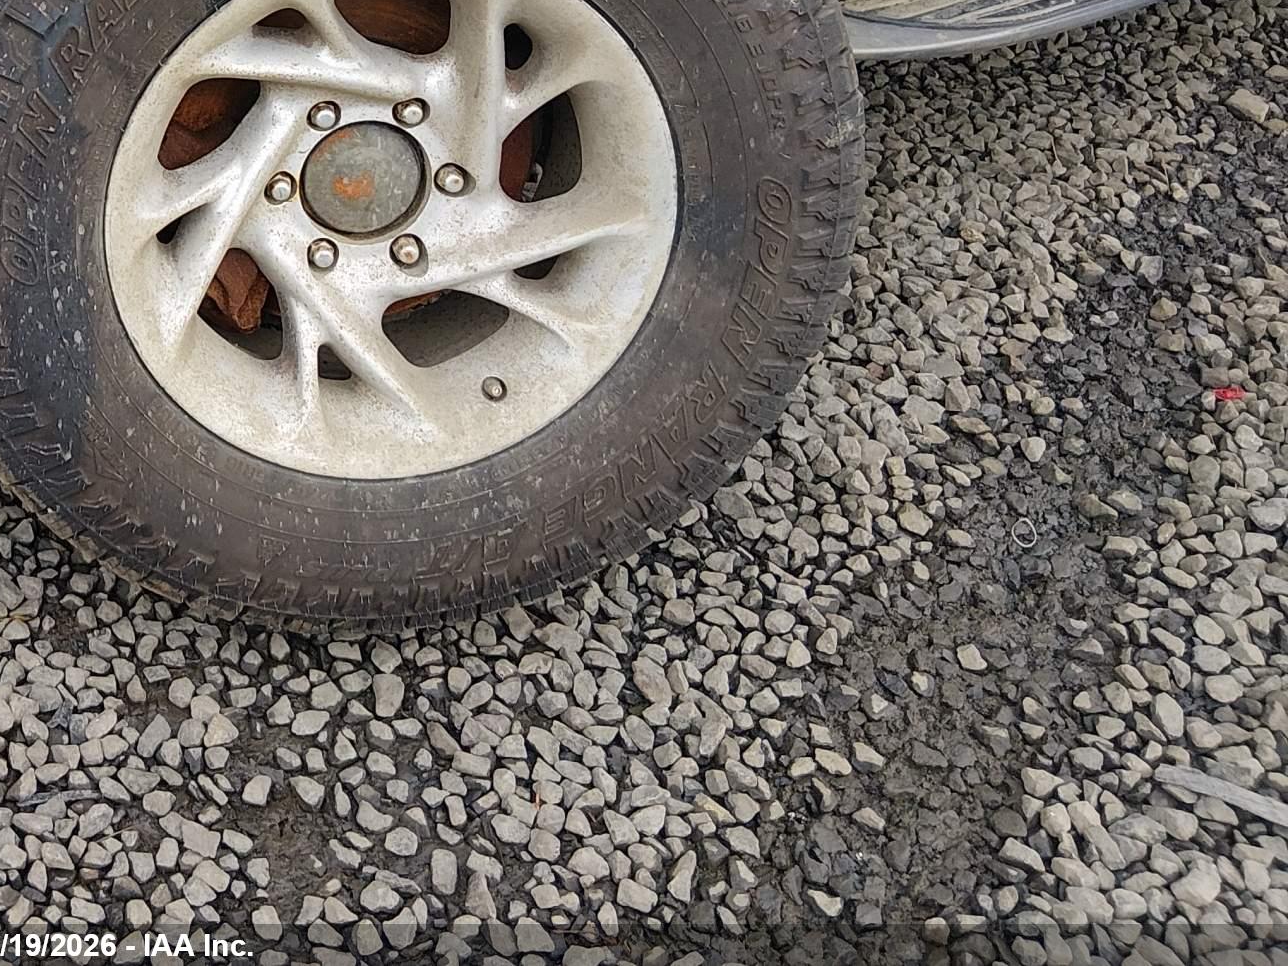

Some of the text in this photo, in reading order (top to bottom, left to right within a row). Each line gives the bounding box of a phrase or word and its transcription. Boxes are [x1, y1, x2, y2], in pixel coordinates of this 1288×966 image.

[0, 89, 61, 287] OPEN
[720, 176, 793, 369] OPEN
[541, 360, 729, 550] RANGE
